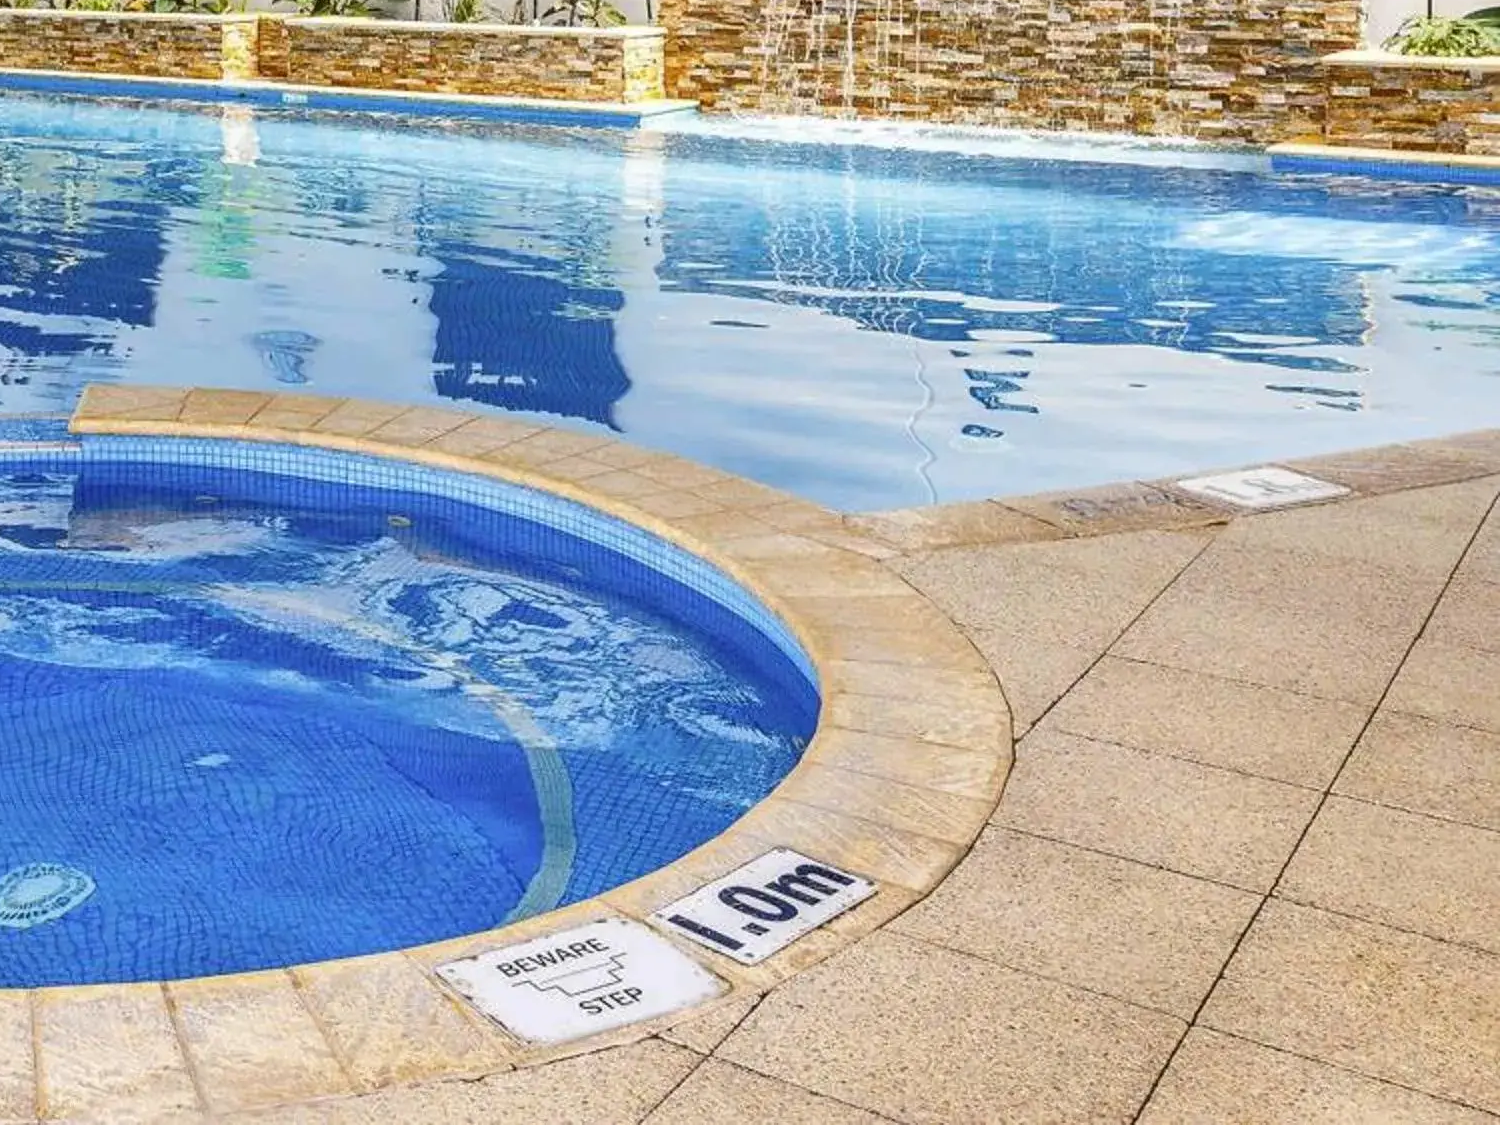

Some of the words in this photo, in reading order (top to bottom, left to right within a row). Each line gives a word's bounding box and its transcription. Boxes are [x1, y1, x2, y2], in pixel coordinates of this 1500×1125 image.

[668, 862, 856, 952] 1.0m
[497, 937, 610, 978] BEWARE
[579, 986, 644, 1017] STEP
